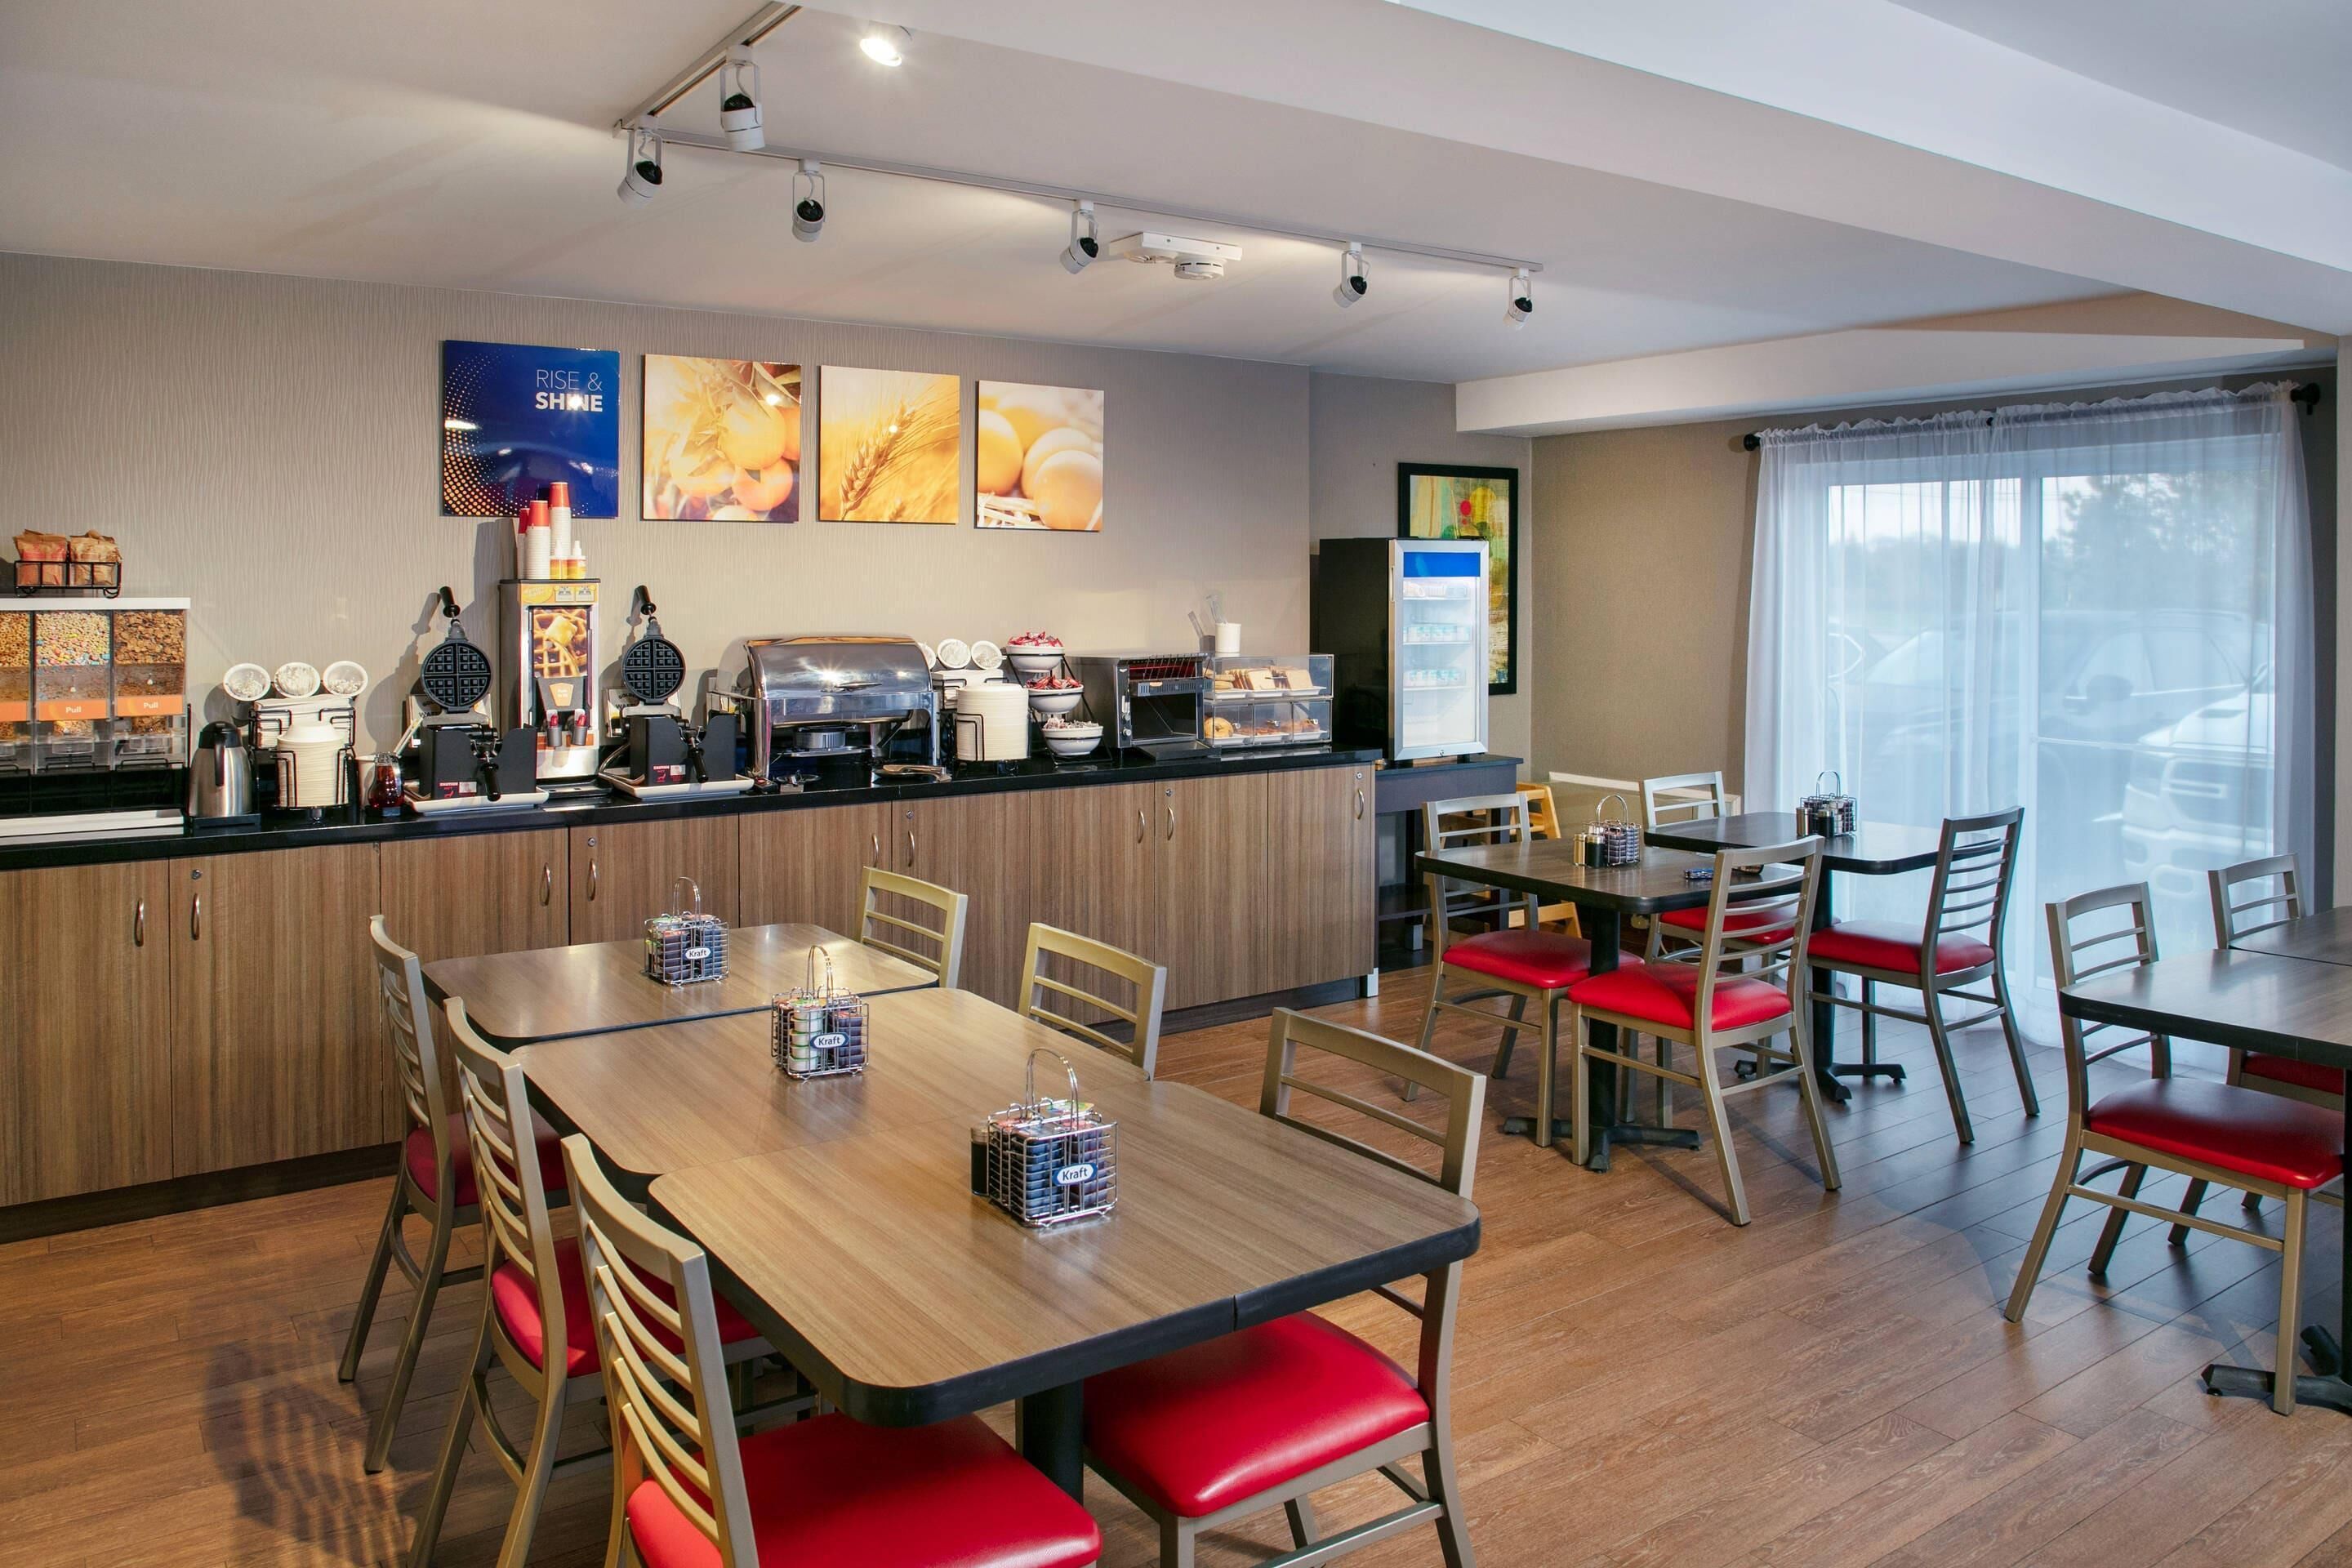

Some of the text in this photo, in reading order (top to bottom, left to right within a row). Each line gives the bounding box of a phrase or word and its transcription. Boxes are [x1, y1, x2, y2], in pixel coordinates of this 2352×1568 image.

[537, 369, 603, 391] RISE &
[535, 392, 603, 412] SHINE
[688, 949, 707, 957] Kraft
[818, 1036, 840, 1045] Kraft
[1062, 1166, 1088, 1181] Kraft
